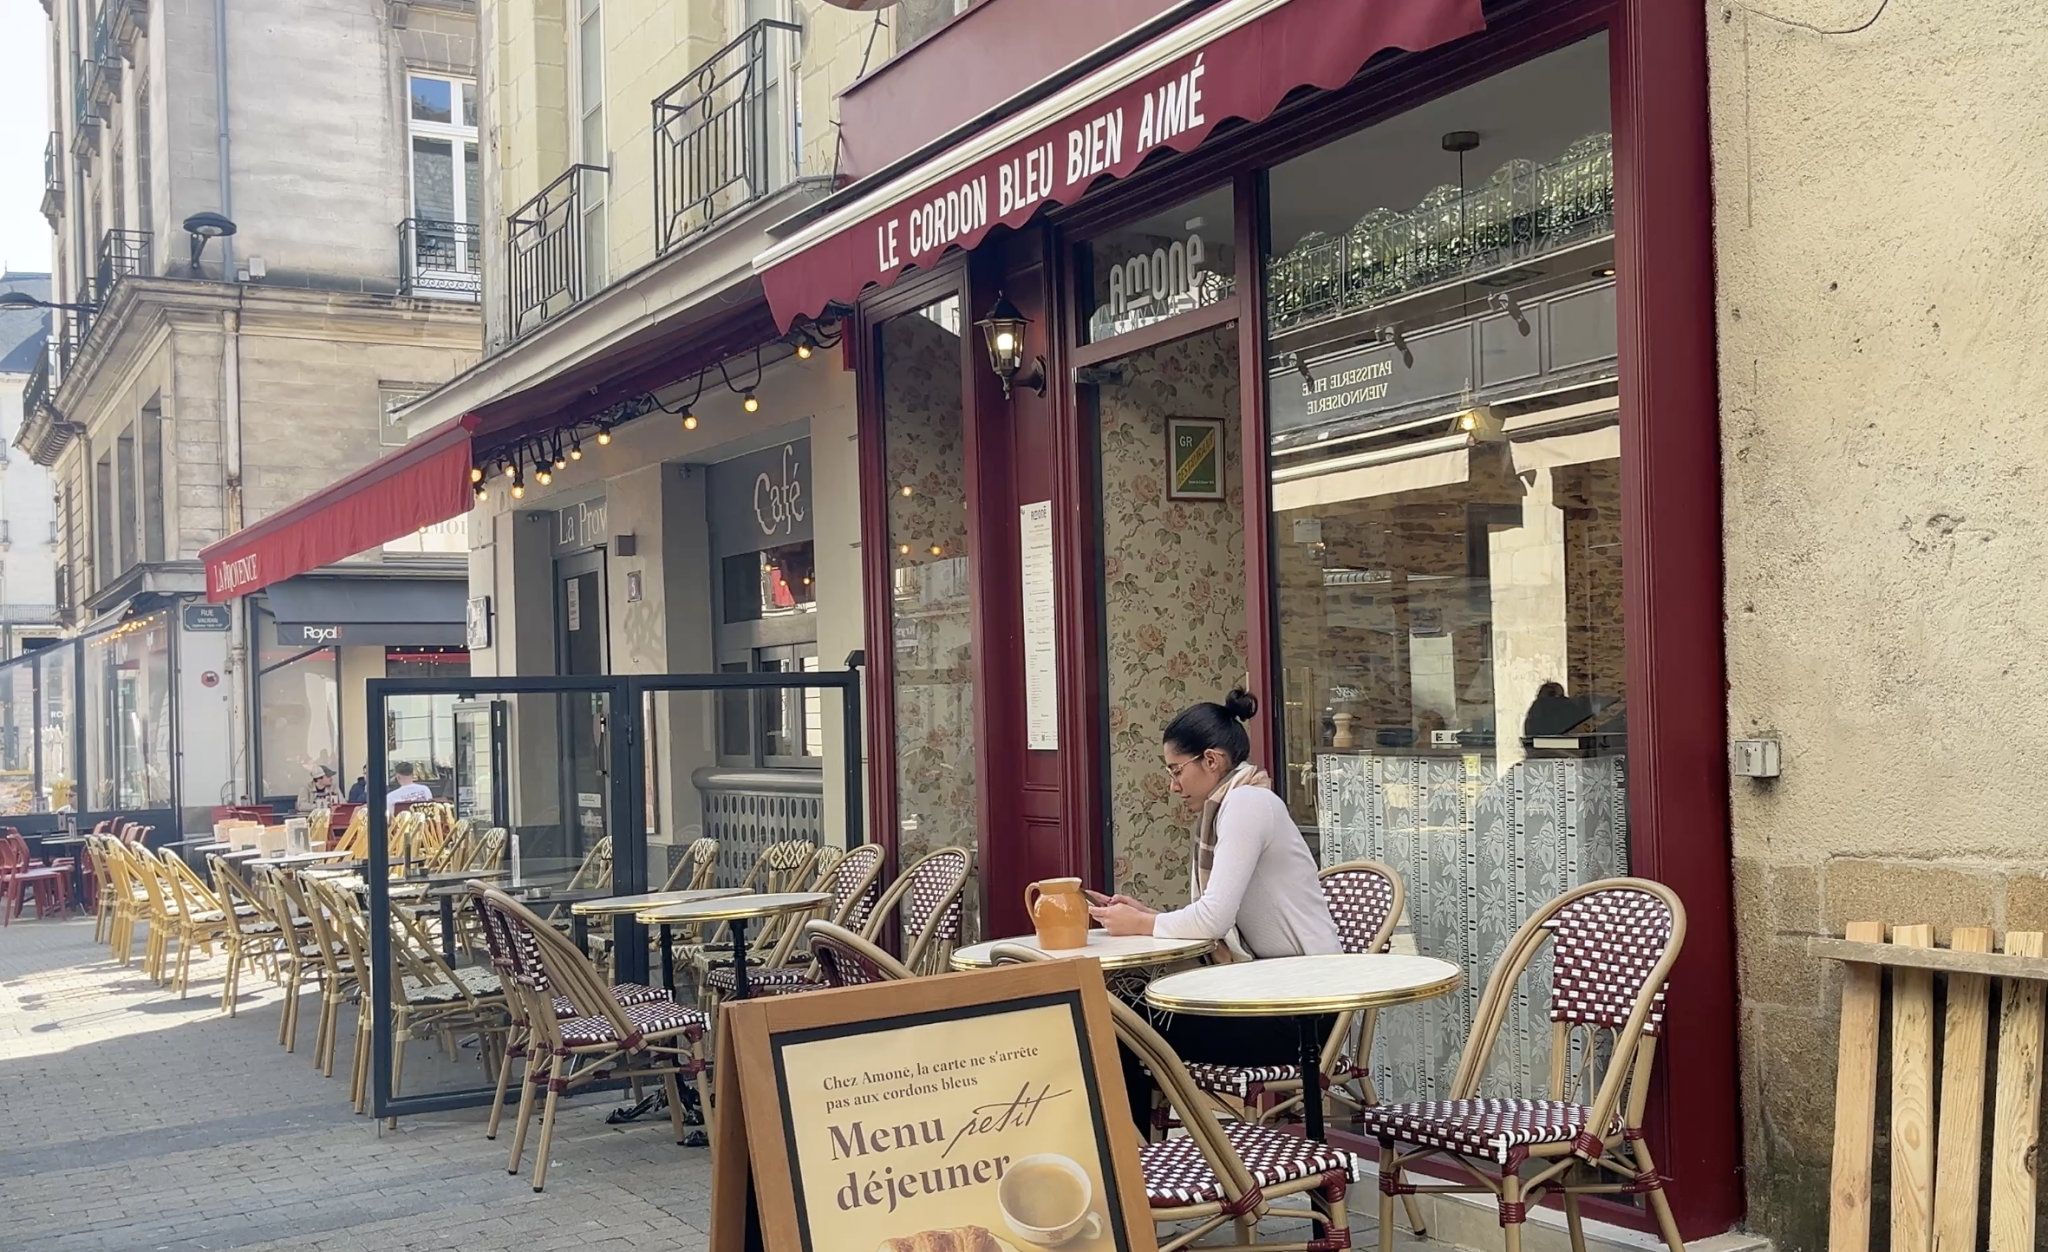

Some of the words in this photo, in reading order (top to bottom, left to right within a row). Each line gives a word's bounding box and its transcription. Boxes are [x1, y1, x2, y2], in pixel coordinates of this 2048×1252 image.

[878, 218, 900, 273] LE
[909, 174, 987, 258] CORDON
[999, 141, 1054, 218] BLEU
[1066, 106, 1123, 186] BIEN
[1136, 51, 1205, 154] AIMÉ
[1179, 435, 1193, 448] GR
[753, 444, 805, 535] Café
[558, 508, 575, 546] La
[200, 608, 215, 617] RUE
[303, 625, 338, 644] Royal
[822, 1075, 859, 1091] Chez
[916, 1062, 930, 1076] la
[932, 1057, 968, 1073] carte
[970, 1055, 987, 1068] ne
[989, 1046, 1040, 1064] s'arrête
[825, 1096, 851, 1115] pas
[853, 1092, 881, 1106] aux
[882, 1082, 939, 1102] cordons
[941, 1076, 979, 1091] bleus
[827, 1117, 946, 1161] Menu
[941, 1080, 1073, 1159] petit
[836, 1154, 1011, 1214] déjeuner
